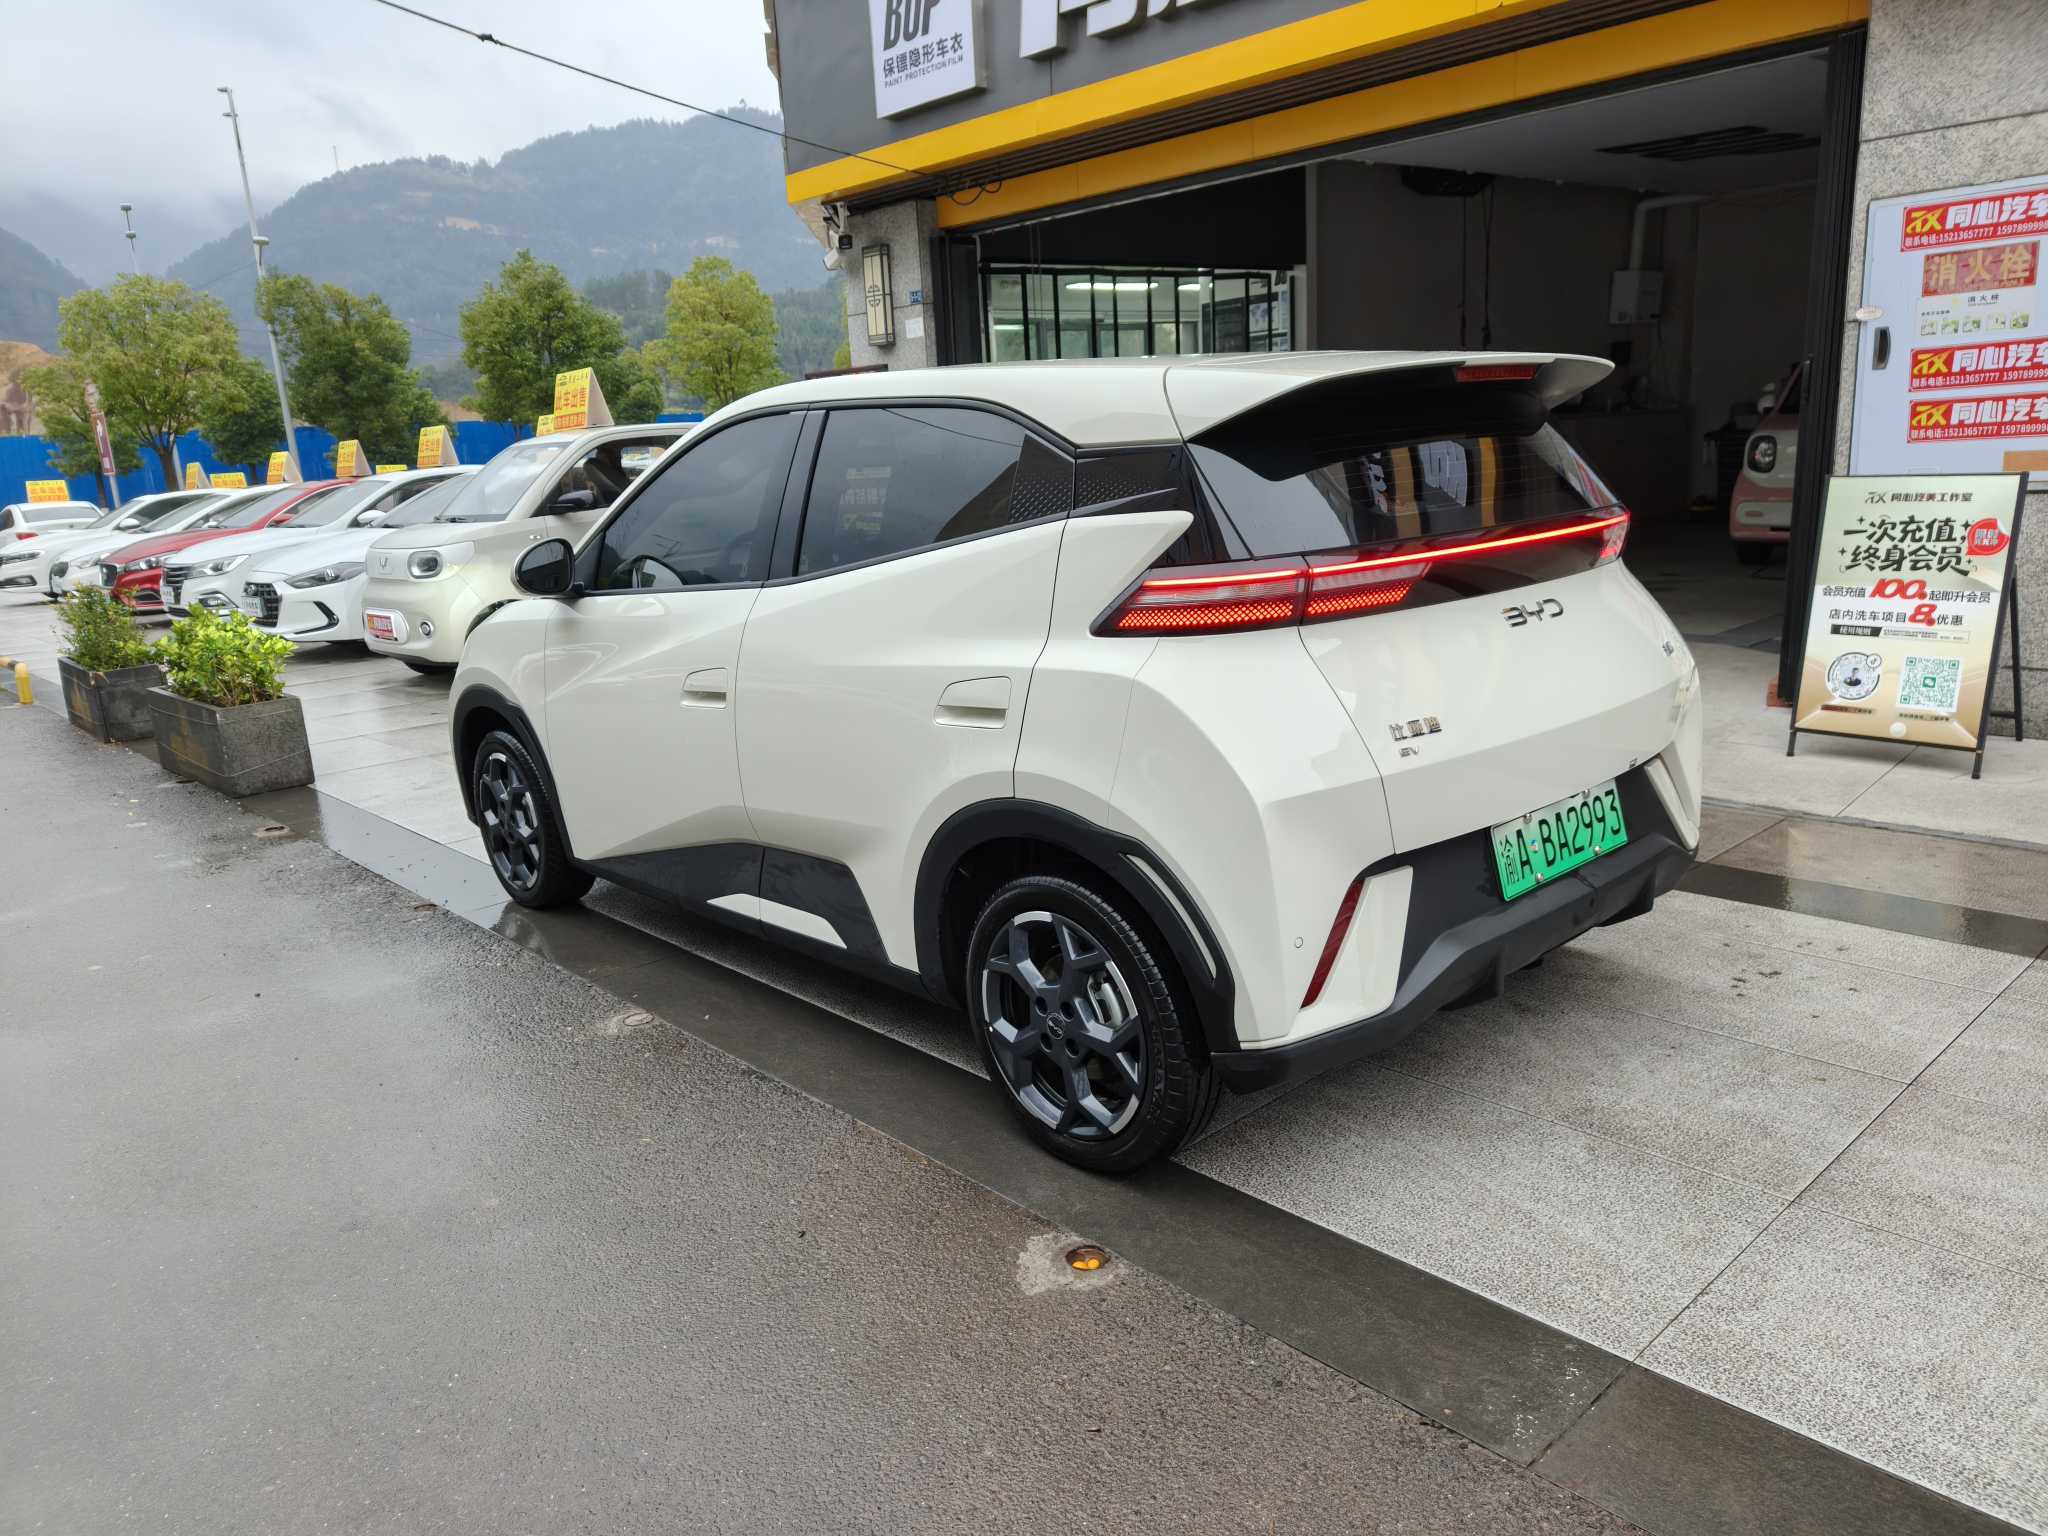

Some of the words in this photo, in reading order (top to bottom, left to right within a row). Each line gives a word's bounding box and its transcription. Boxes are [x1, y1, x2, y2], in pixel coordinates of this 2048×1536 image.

[884, 75, 903, 88] PAINT
[905, 61, 947, 81] PROTECTION
[1929, 245, 2032, 289] 消火栓
[1845, 544, 1970, 577] 终身会员
[1822, 585, 1866, 598] 会员充值
[1929, 590, 1991, 603] 起即升会员
[1502, 598, 1564, 628] BYD
[1829, 608, 1907, 623] 店内洗车项目
[1937, 614, 1963, 626] 优惠
